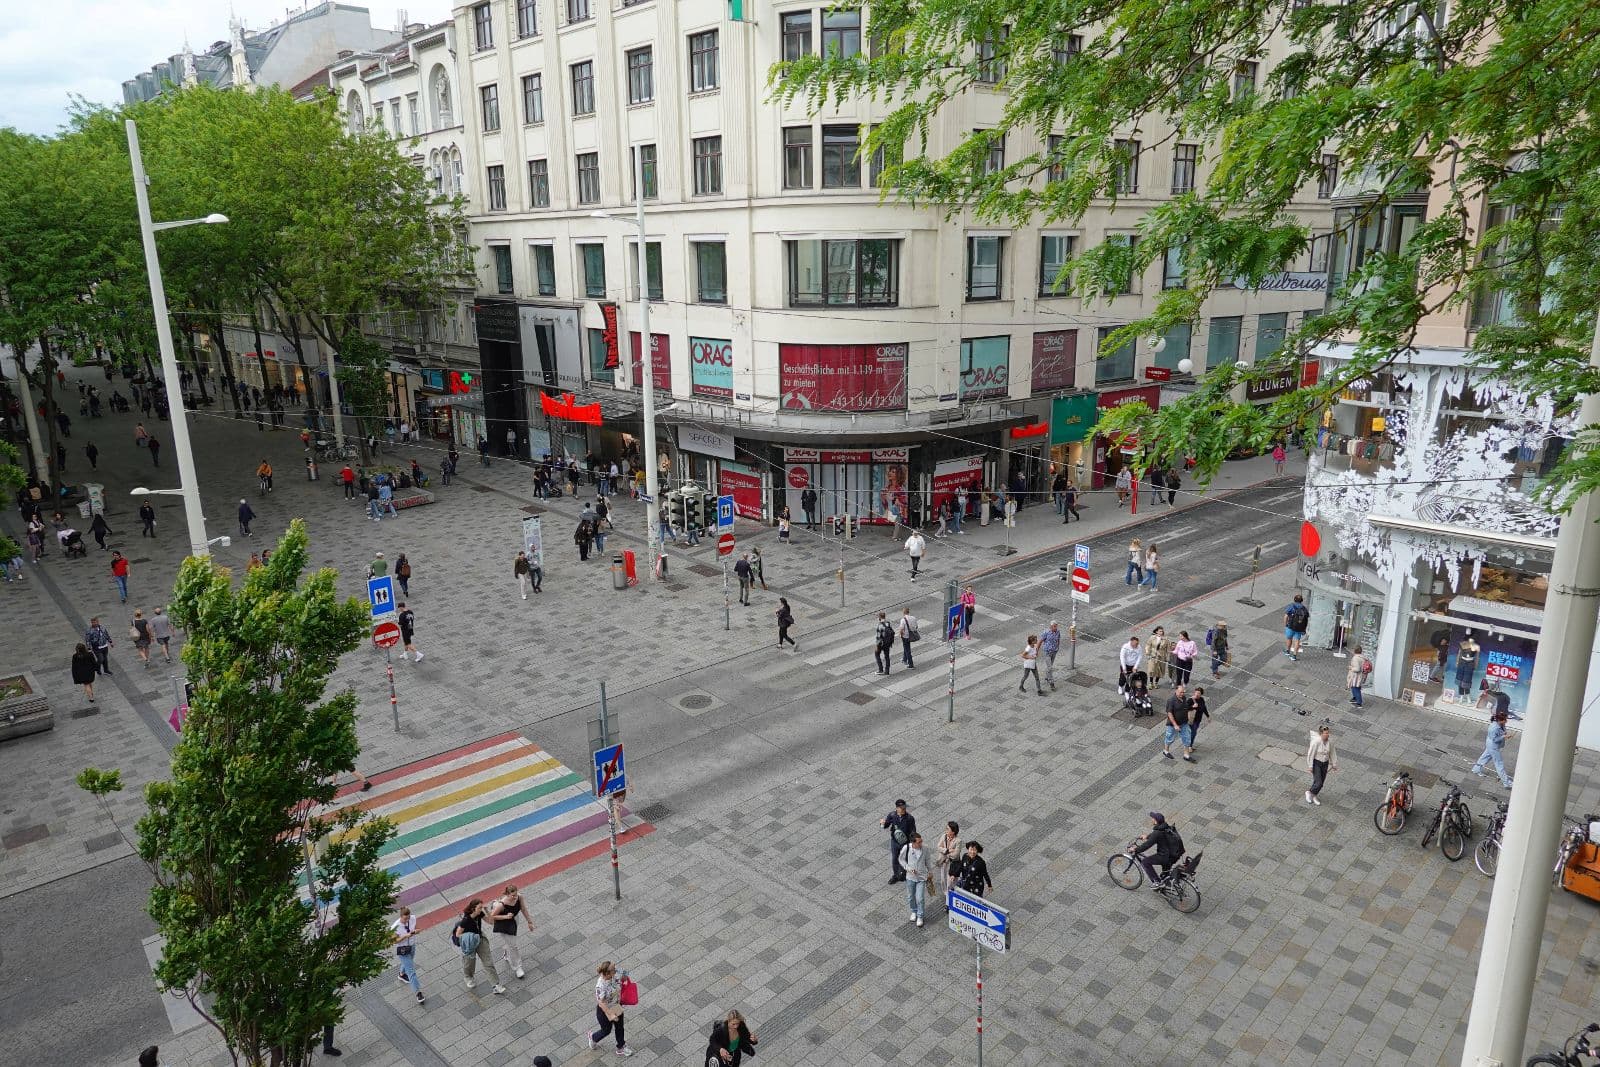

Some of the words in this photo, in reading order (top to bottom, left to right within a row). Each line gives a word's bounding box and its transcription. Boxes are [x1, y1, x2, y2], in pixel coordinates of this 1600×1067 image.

[692, 342, 732, 367] ORAG
[877, 346, 904, 358] ORAG
[794, 377, 816, 388] mieten
[963, 365, 1007, 387] ORAG
[1488, 657, 1520, 669] DEAL
[1489, 651, 1522, 663] DENIM
[1487, 665, 1518, 680] -30%
[955, 899, 987, 921] EINBAHN
